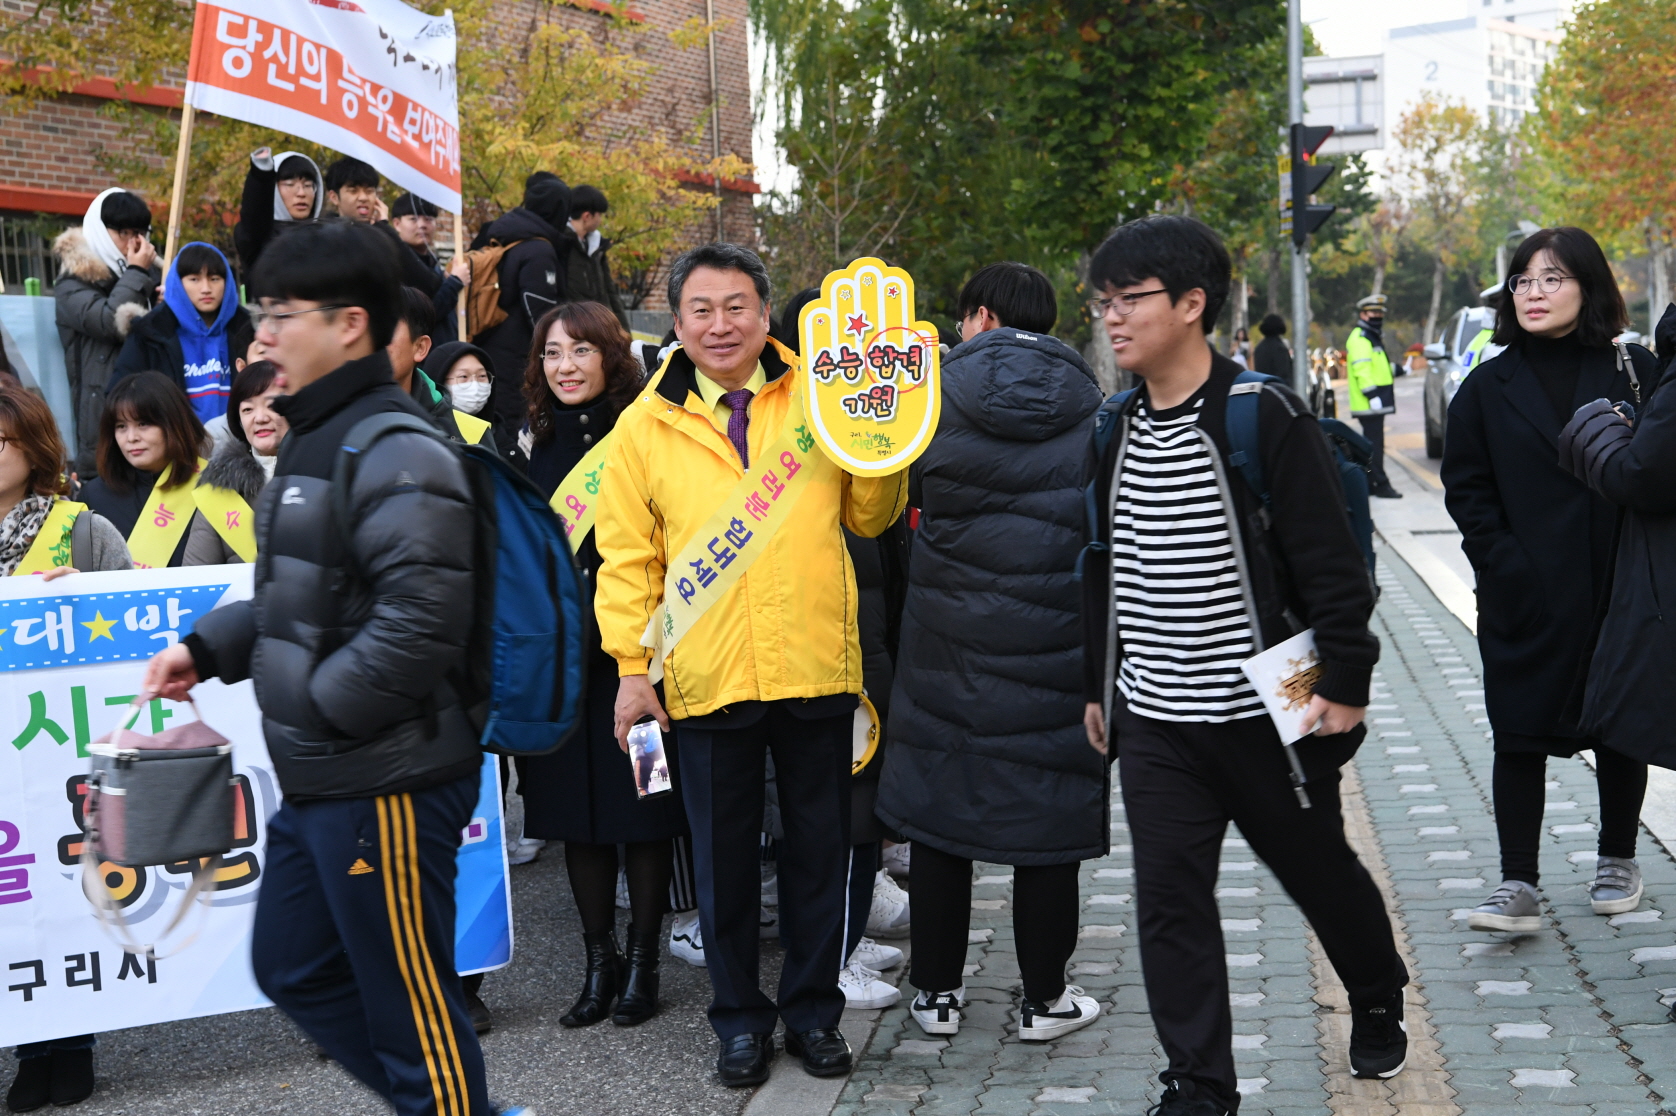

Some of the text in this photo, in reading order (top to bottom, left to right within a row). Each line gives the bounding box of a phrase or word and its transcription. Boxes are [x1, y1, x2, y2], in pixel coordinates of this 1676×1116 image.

[216, 10, 327, 105] 당신의
[1425, 60, 1439, 81] 2
[813, 345, 923, 381] 수능 합격
[842, 384, 895, 418] 기원
[850, 437, 873, 450] 시민
[744, 451, 802, 522] 여러분
[675, 517, 754, 606] 힘내세요
[11, 605, 75, 654] 대
[8, 945, 157, 1002] 구리시
[935, 996, 951, 1004] NIKE
